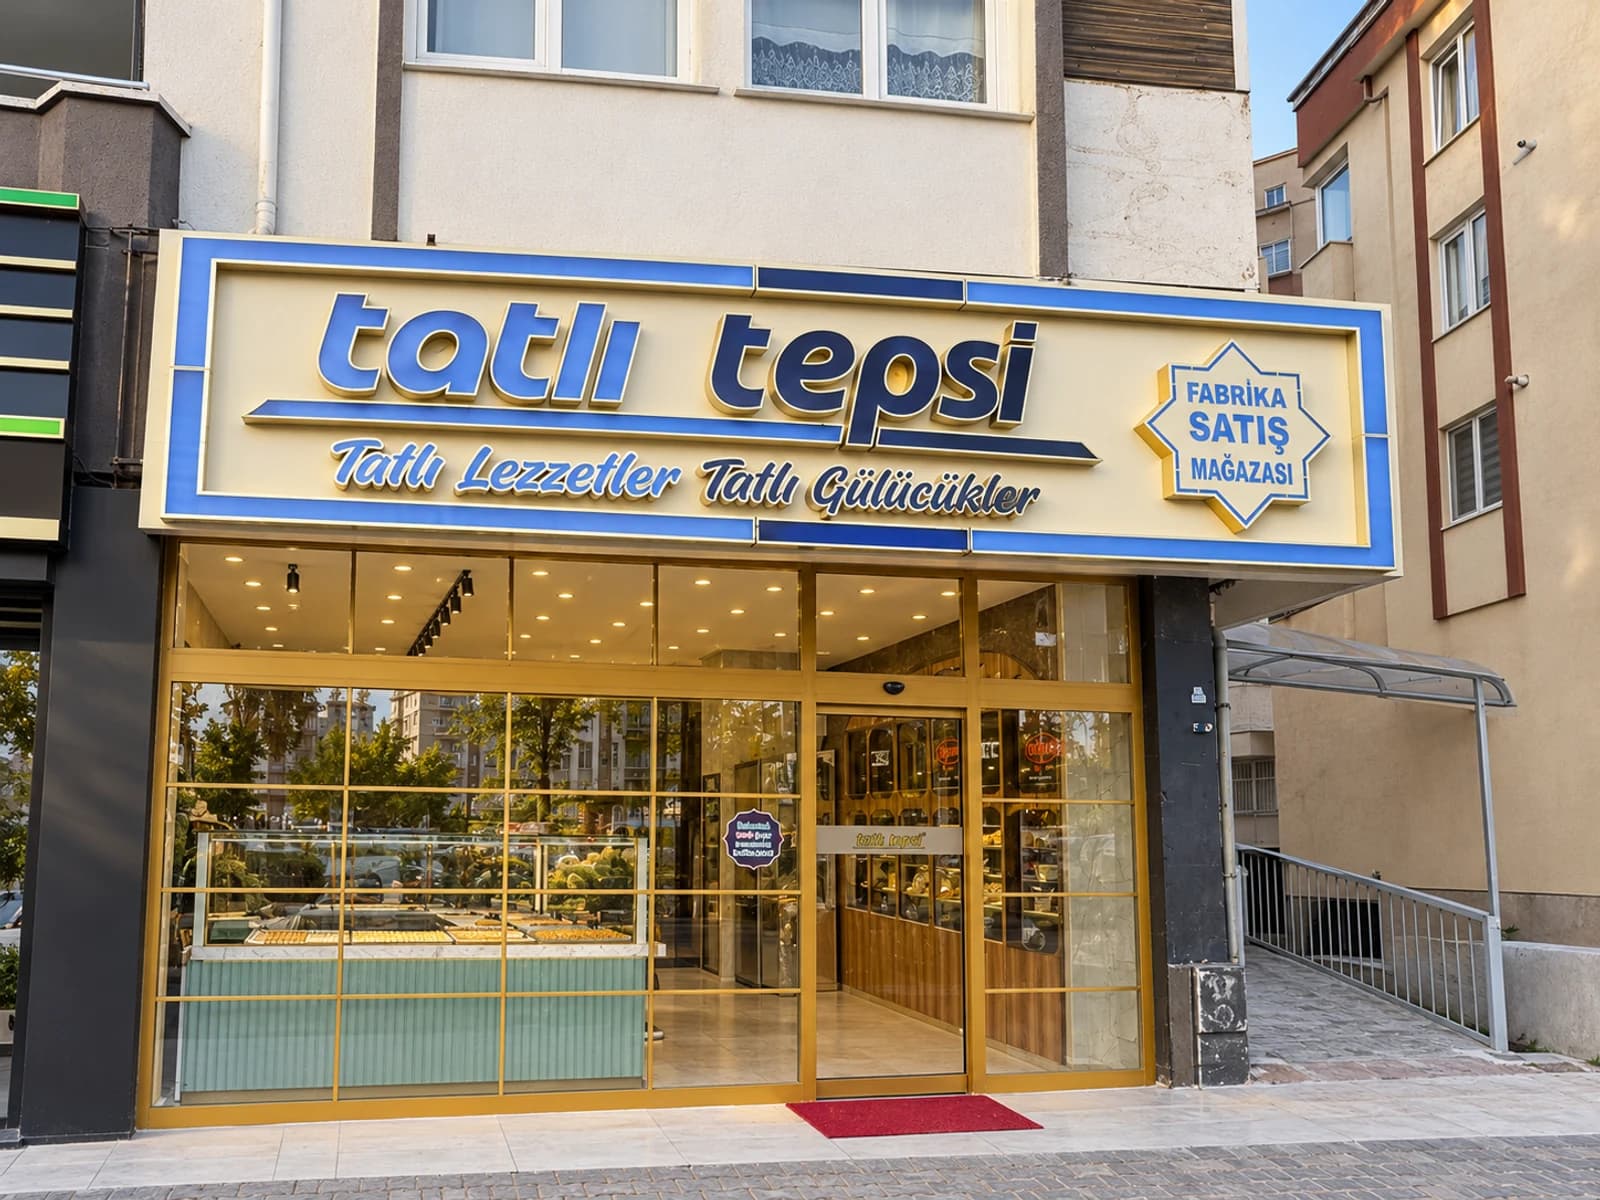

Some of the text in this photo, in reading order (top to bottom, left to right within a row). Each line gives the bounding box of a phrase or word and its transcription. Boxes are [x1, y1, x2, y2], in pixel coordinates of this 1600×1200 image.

[317, 292, 1039, 447] tatlı tepsi
[1186, 378, 1287, 409] FABRİKA
[1189, 411, 1290, 455] SATIŞ
[331, 438, 1041, 517] Tatlı Lezzetler Tatlı Gülücükler
[1191, 453, 1293, 486] MAĞAZASI
